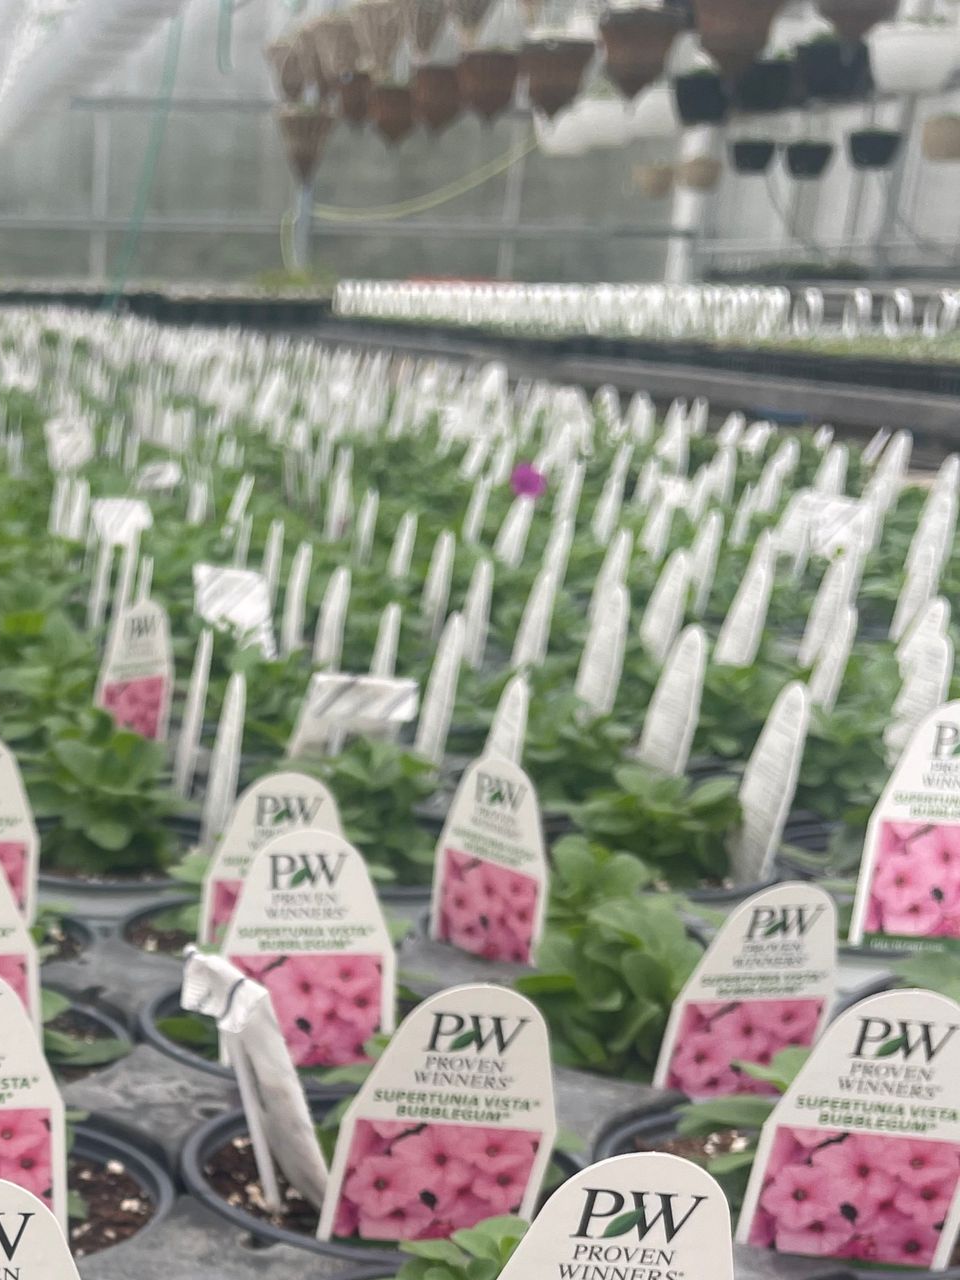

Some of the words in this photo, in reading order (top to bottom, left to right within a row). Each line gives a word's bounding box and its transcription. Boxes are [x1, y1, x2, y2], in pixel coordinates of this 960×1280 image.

[256, 796, 325, 826] PW
[268, 854, 349, 890] PW
[743, 904, 827, 941] PW
[423, 1012, 531, 1055] PW
[849, 1016, 959, 1063] PW
[425, 1055, 506, 1073] PROVEN
[850, 1062, 936, 1081] PROVEN
[373, 1090, 478, 1107] SUPERTUNIA
[569, 1187, 708, 1243] PW
[573, 1244, 676, 1266] PROVEN
